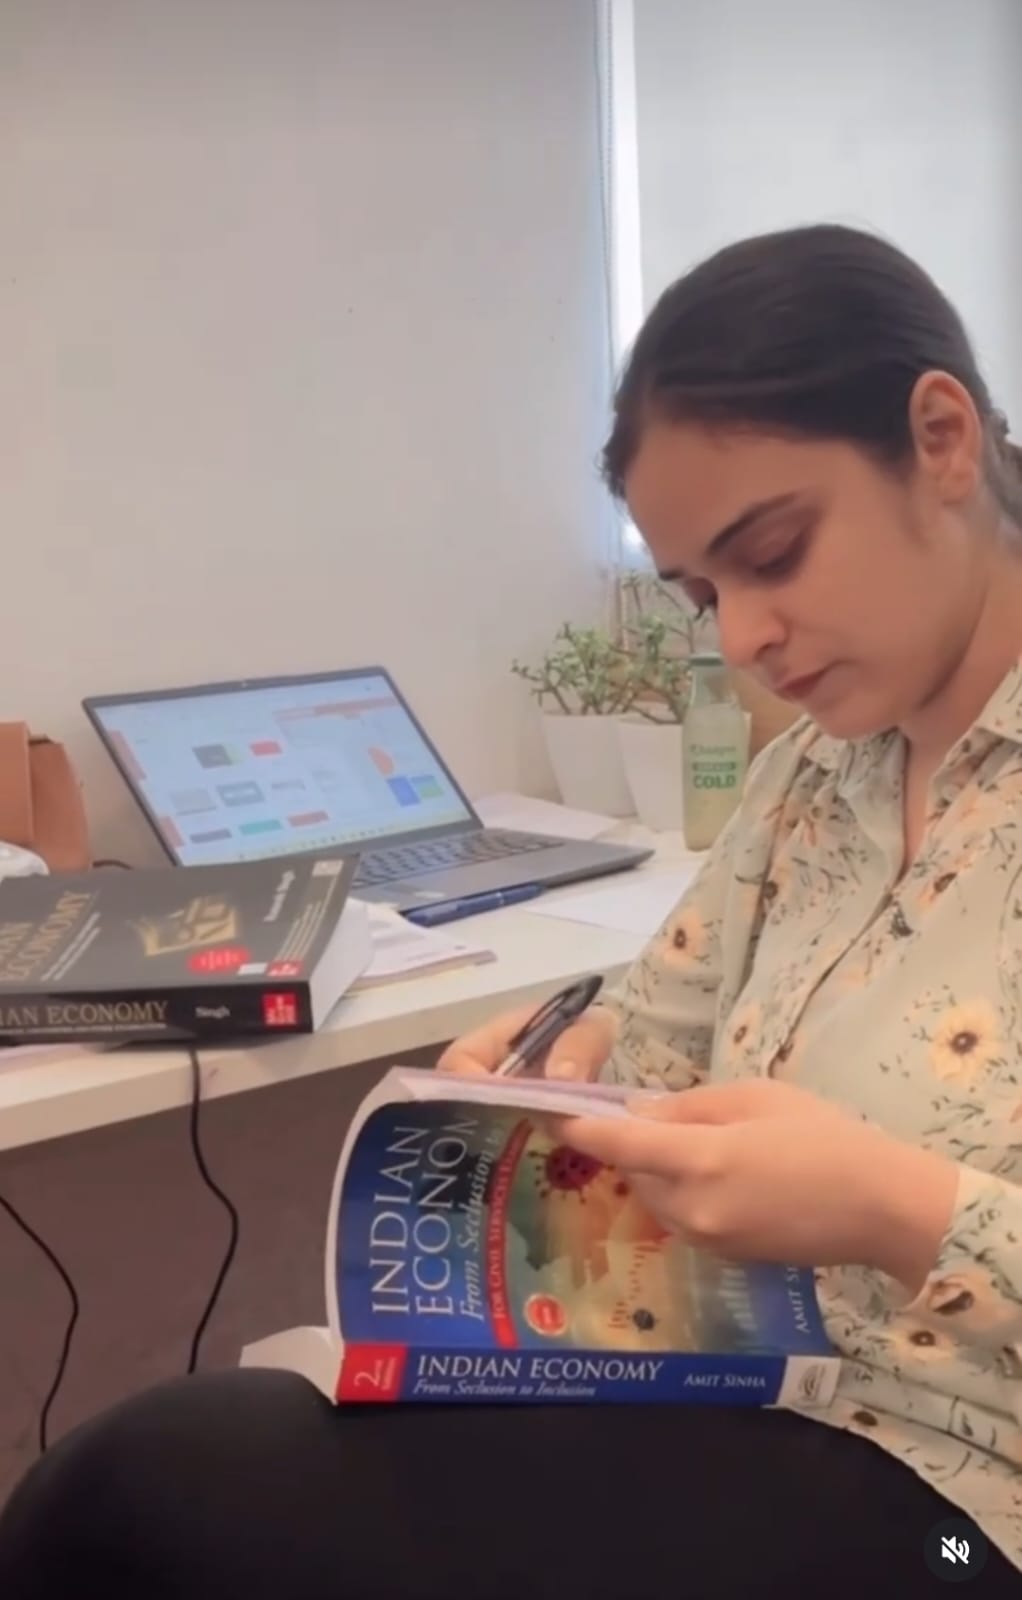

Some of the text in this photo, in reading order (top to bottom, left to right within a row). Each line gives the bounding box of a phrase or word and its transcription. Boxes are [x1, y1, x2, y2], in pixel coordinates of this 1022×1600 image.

[47, 1001, 167, 1025] ECONOMY
[369, 1126, 429, 1315] INDIAN
[457, 1150, 497, 1254] Seclusion
[460, 1259, 485, 1322] From
[788, 1287, 811, 1334] AMIT
[417, 1354, 521, 1379] INDIAN
[530, 1357, 664, 1382] ECONOMY
[684, 1373, 766, 1388] AMIT SINHA
[413, 1379, 450, 1395] From
[453, 1380, 516, 1396] Seclusion
[536, 1381, 596, 1397] Inclusion
